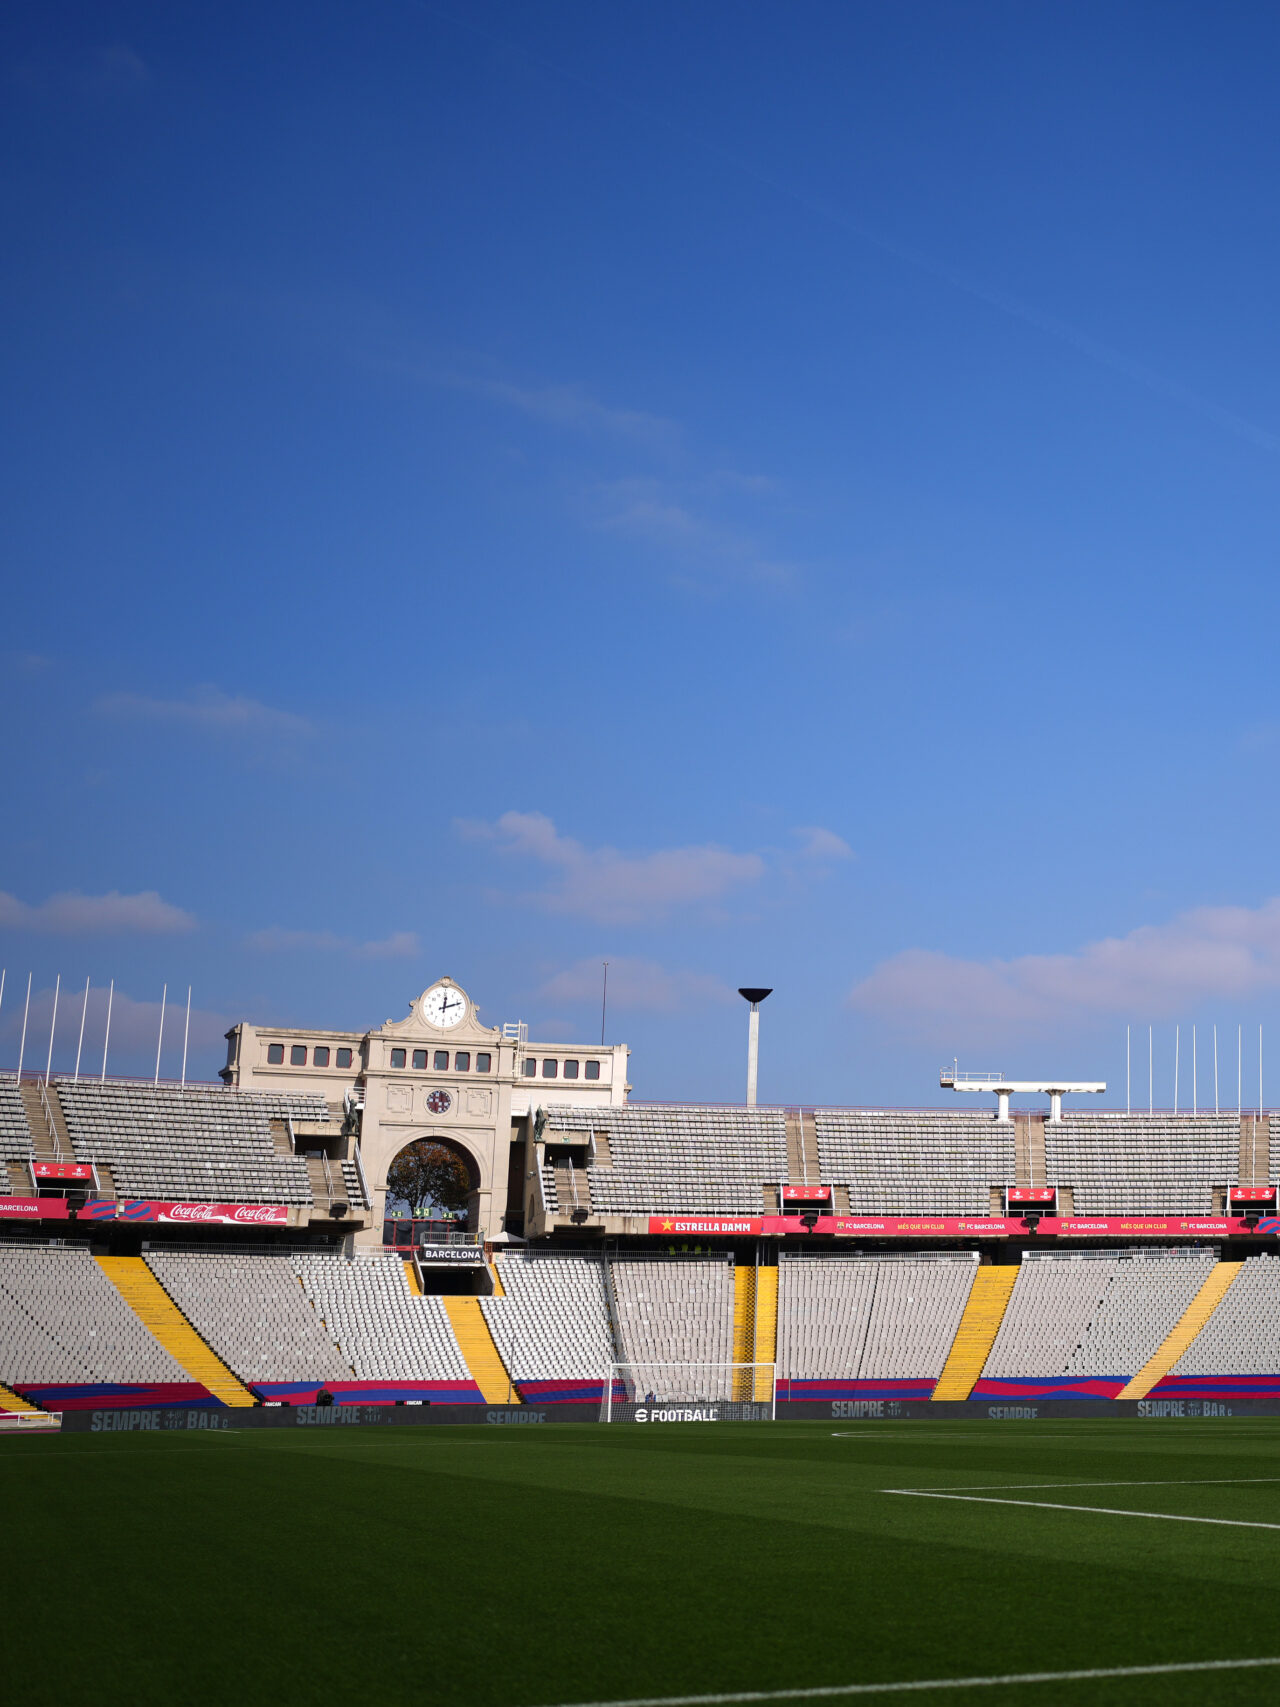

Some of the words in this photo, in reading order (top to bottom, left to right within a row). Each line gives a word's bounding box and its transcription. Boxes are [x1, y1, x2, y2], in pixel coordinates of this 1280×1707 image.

[170, 1204, 217, 1219] Coca-Cola
[235, 1206, 280, 1220] Coca-Cola
[675, 1222, 720, 1231] ESTRELLA
[721, 1223, 750, 1232] DAMM
[425, 1250, 480, 1259] BARCELONA
[296, 1406, 361, 1424] SEMPRE
[831, 1400, 884, 1418] SEMPRE
[1137, 1400, 1185, 1417] SEMPRE
[90, 1410, 160, 1432] SEMPRE
